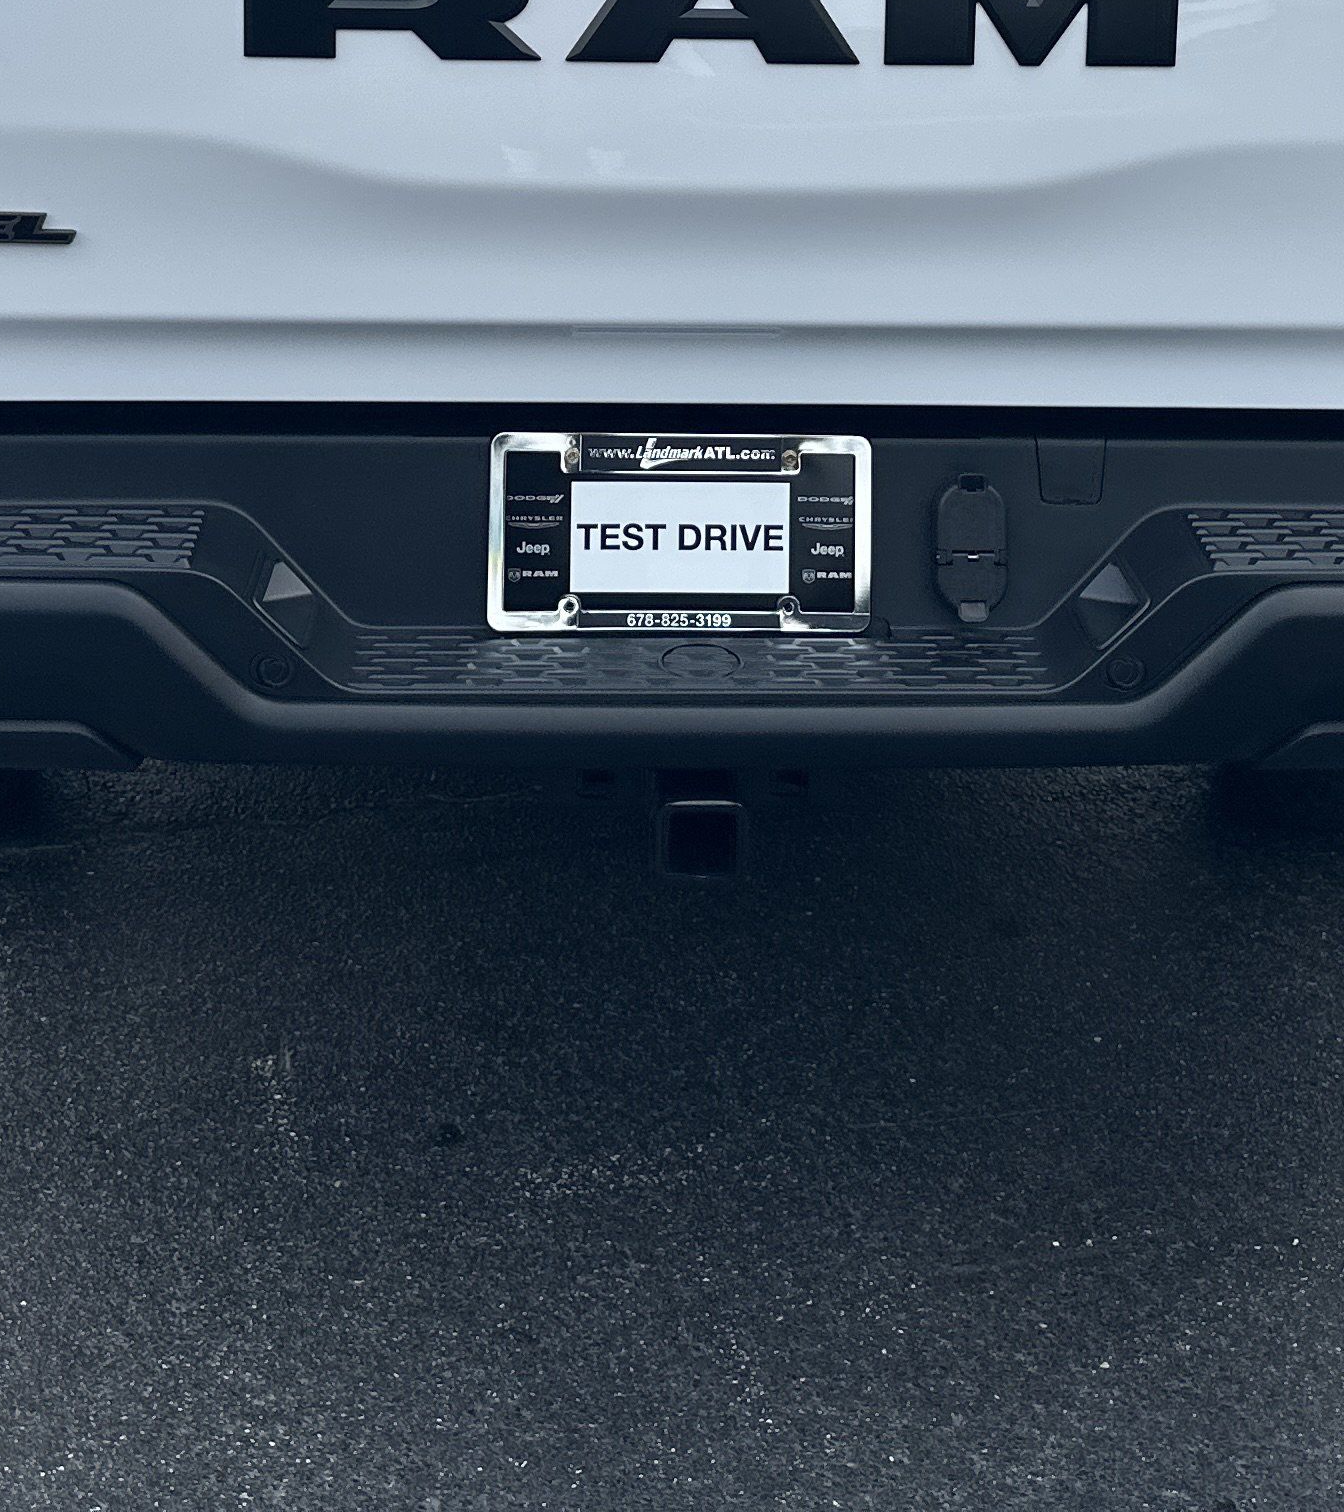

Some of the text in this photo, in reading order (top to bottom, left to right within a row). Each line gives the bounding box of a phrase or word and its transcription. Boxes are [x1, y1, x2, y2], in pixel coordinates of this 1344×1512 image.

[588, 438, 776, 469] www.LandmarkATL.com
[577, 523, 784, 552] TEST DRIVE
[516, 541, 549, 556] Jeep
[810, 542, 844, 557] Jeep
[816, 571, 852, 579] RAM
[626, 613, 732, 627] 678-825-3199
